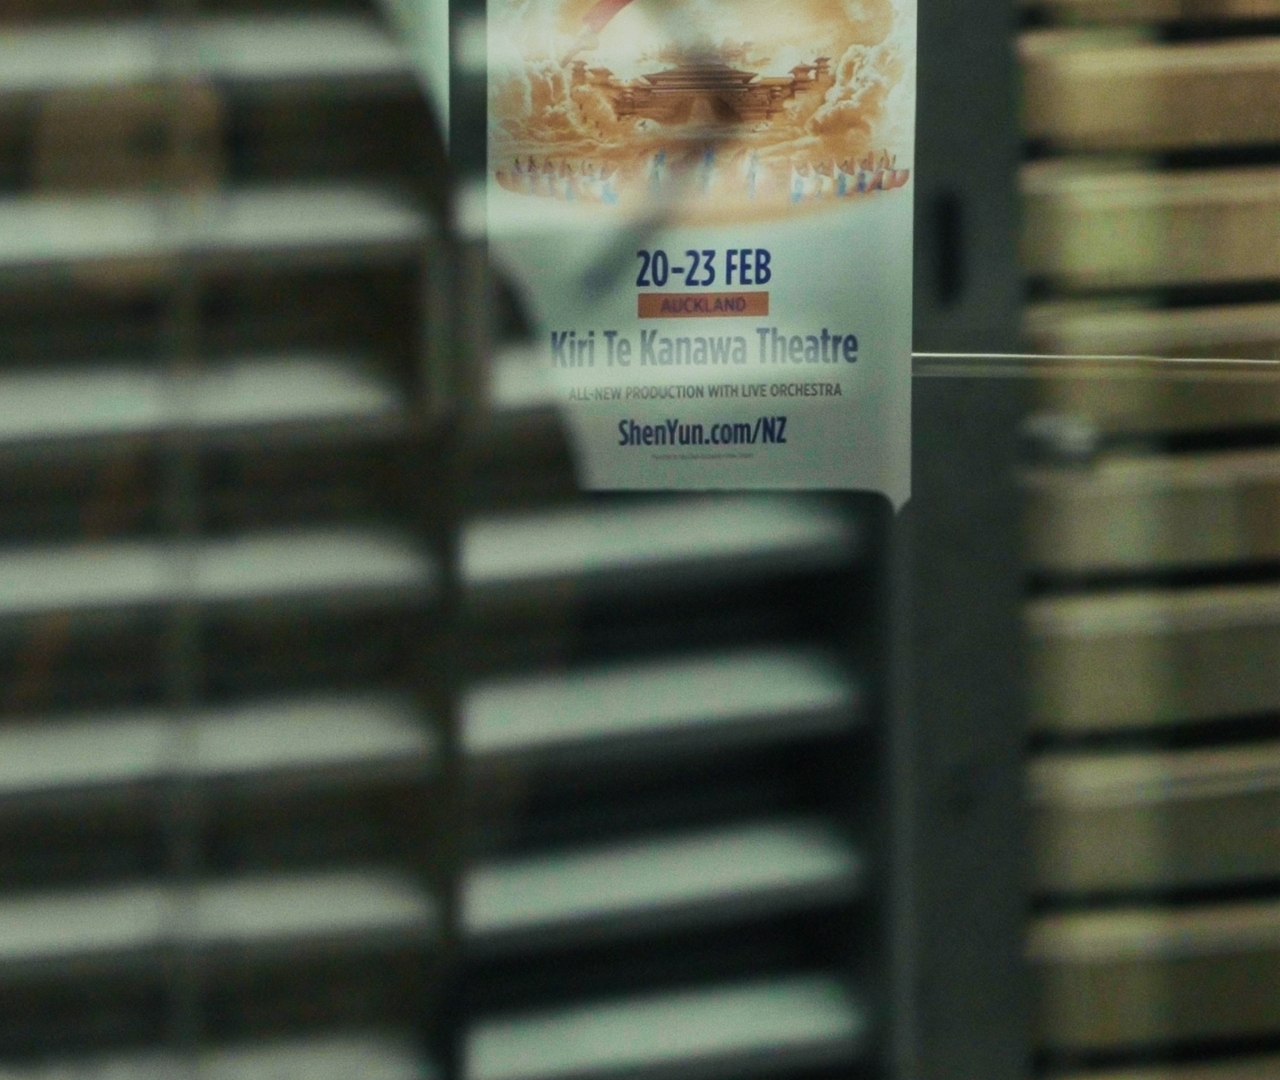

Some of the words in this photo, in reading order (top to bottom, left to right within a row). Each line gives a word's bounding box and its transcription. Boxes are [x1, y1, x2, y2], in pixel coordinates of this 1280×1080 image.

[725, 249, 772, 285] FEB
[661, 296, 747, 314] AUCKLAND
[550, 331, 595, 369] Kiri
[603, 330, 631, 367] Te
[640, 329, 747, 366] Kanawa
[756, 327, 859, 364] Theatre
[569, 387, 620, 401] ALL-NEW
[626, 385, 704, 400] PRODUCTION
[708, 385, 738, 398] WITH
[742, 384, 767, 398] LIVE
[770, 383, 842, 397] ORCHESTRA
[618, 417, 788, 447] ShenYun.com/NZ
